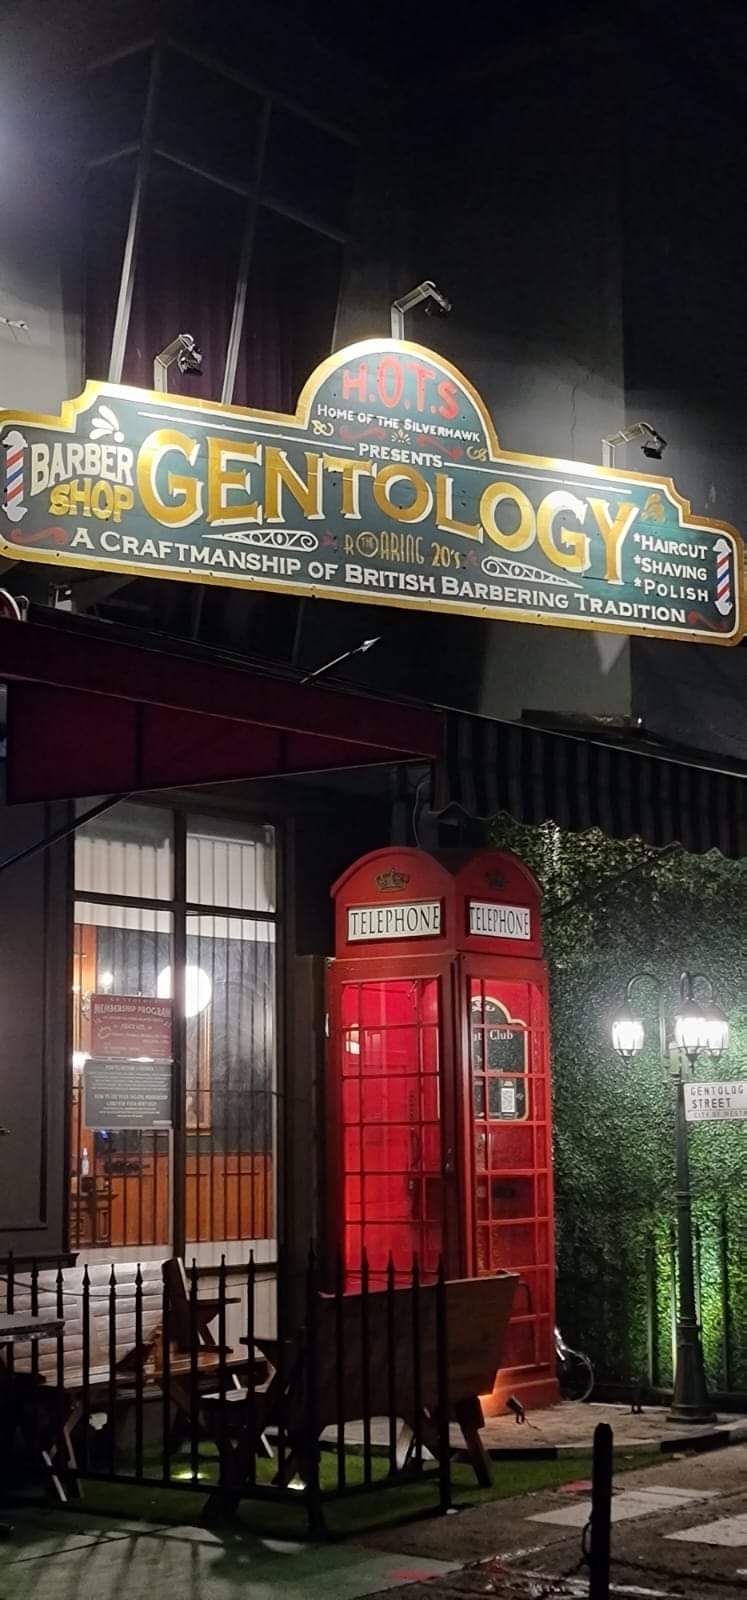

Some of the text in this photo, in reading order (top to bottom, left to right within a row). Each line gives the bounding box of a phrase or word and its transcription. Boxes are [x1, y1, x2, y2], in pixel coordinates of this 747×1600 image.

[342, 355, 459, 420] H.O.T.S
[317, 403, 481, 443] HOME OF THE SILVERHAWK
[30, 442, 134, 497] BARBER
[359, 443, 443, 468] PRESENTS
[48, 478, 135, 523] SHOP
[137, 428, 639, 585] GENTOLOGY
[343, 530, 425, 565] ROARING
[70, 527, 687, 624] A CRAFTMANSHIP OF BRITISH BARBERING TRADITION
[350, 905, 440, 936] TELEPHONE
[470, 906, 529, 936] TELEPHONE
[489, 1029, 514, 1041] Club
[692, 1097, 731, 1109] STREET
